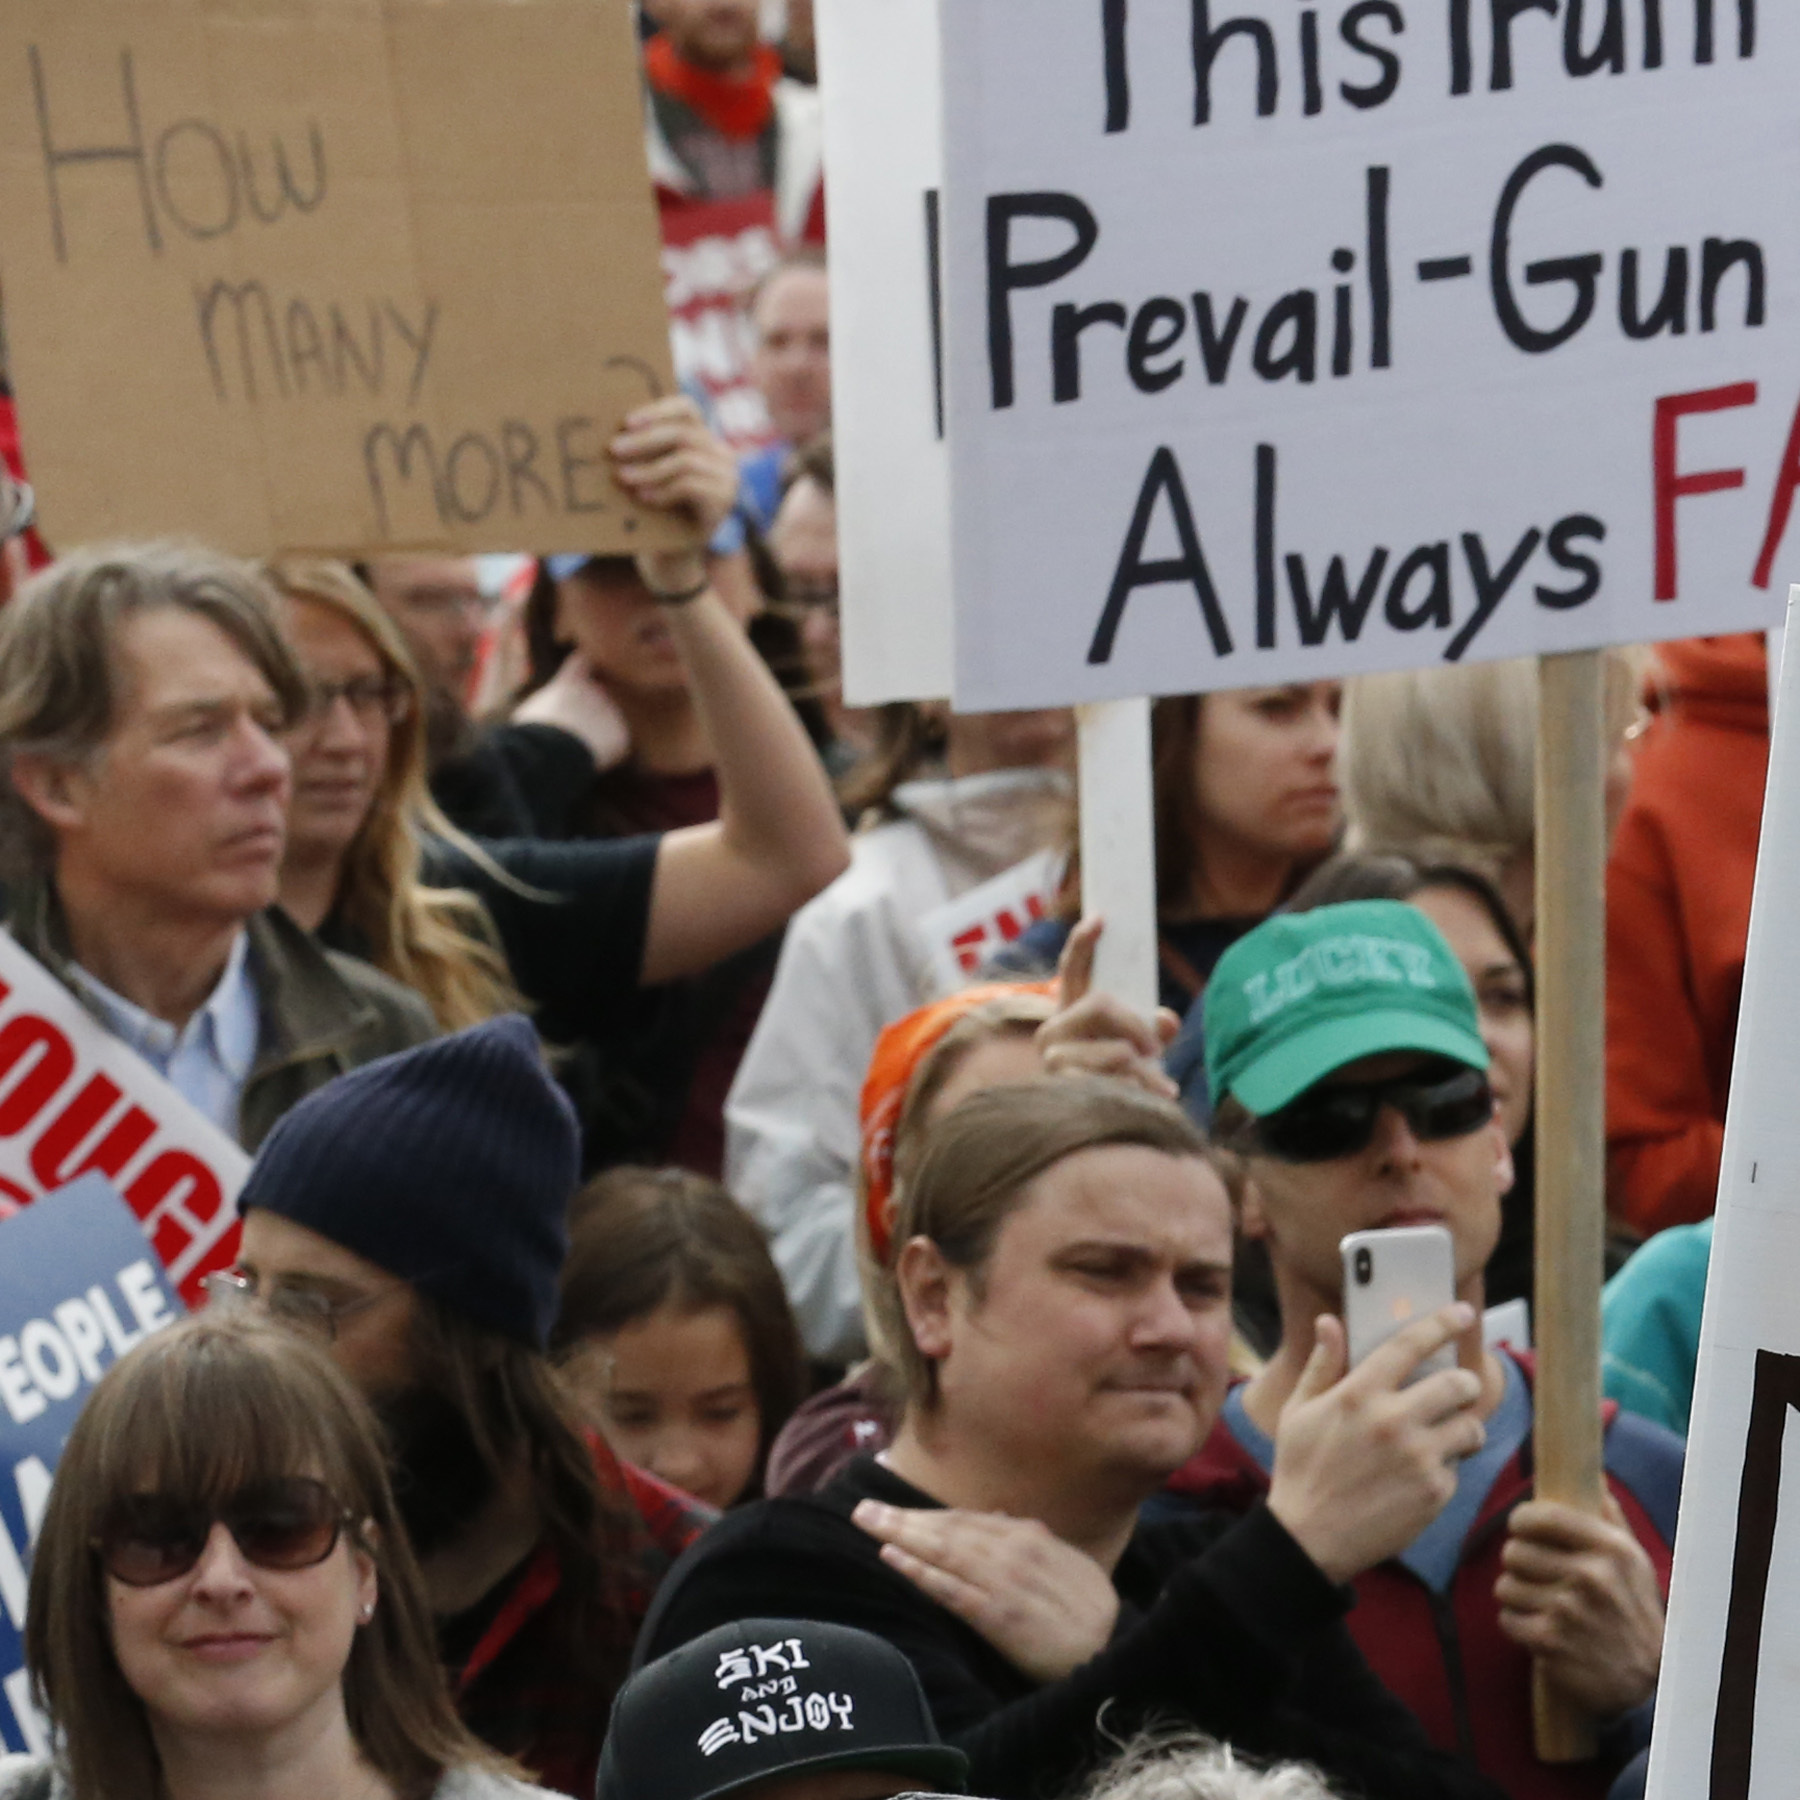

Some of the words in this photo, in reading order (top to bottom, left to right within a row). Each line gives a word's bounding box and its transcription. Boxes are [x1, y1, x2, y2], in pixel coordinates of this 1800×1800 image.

[199, 278, 441, 407] MANY
[1087, 443, 1606, 665] Always
[1243, 934, 1437, 1024] LUCKY
[0, 975, 245, 1315] OUG
[714, 1637, 811, 1690] SKI
[740, 1674, 798, 1702] AND
[697, 1691, 855, 1757] ENJOY
